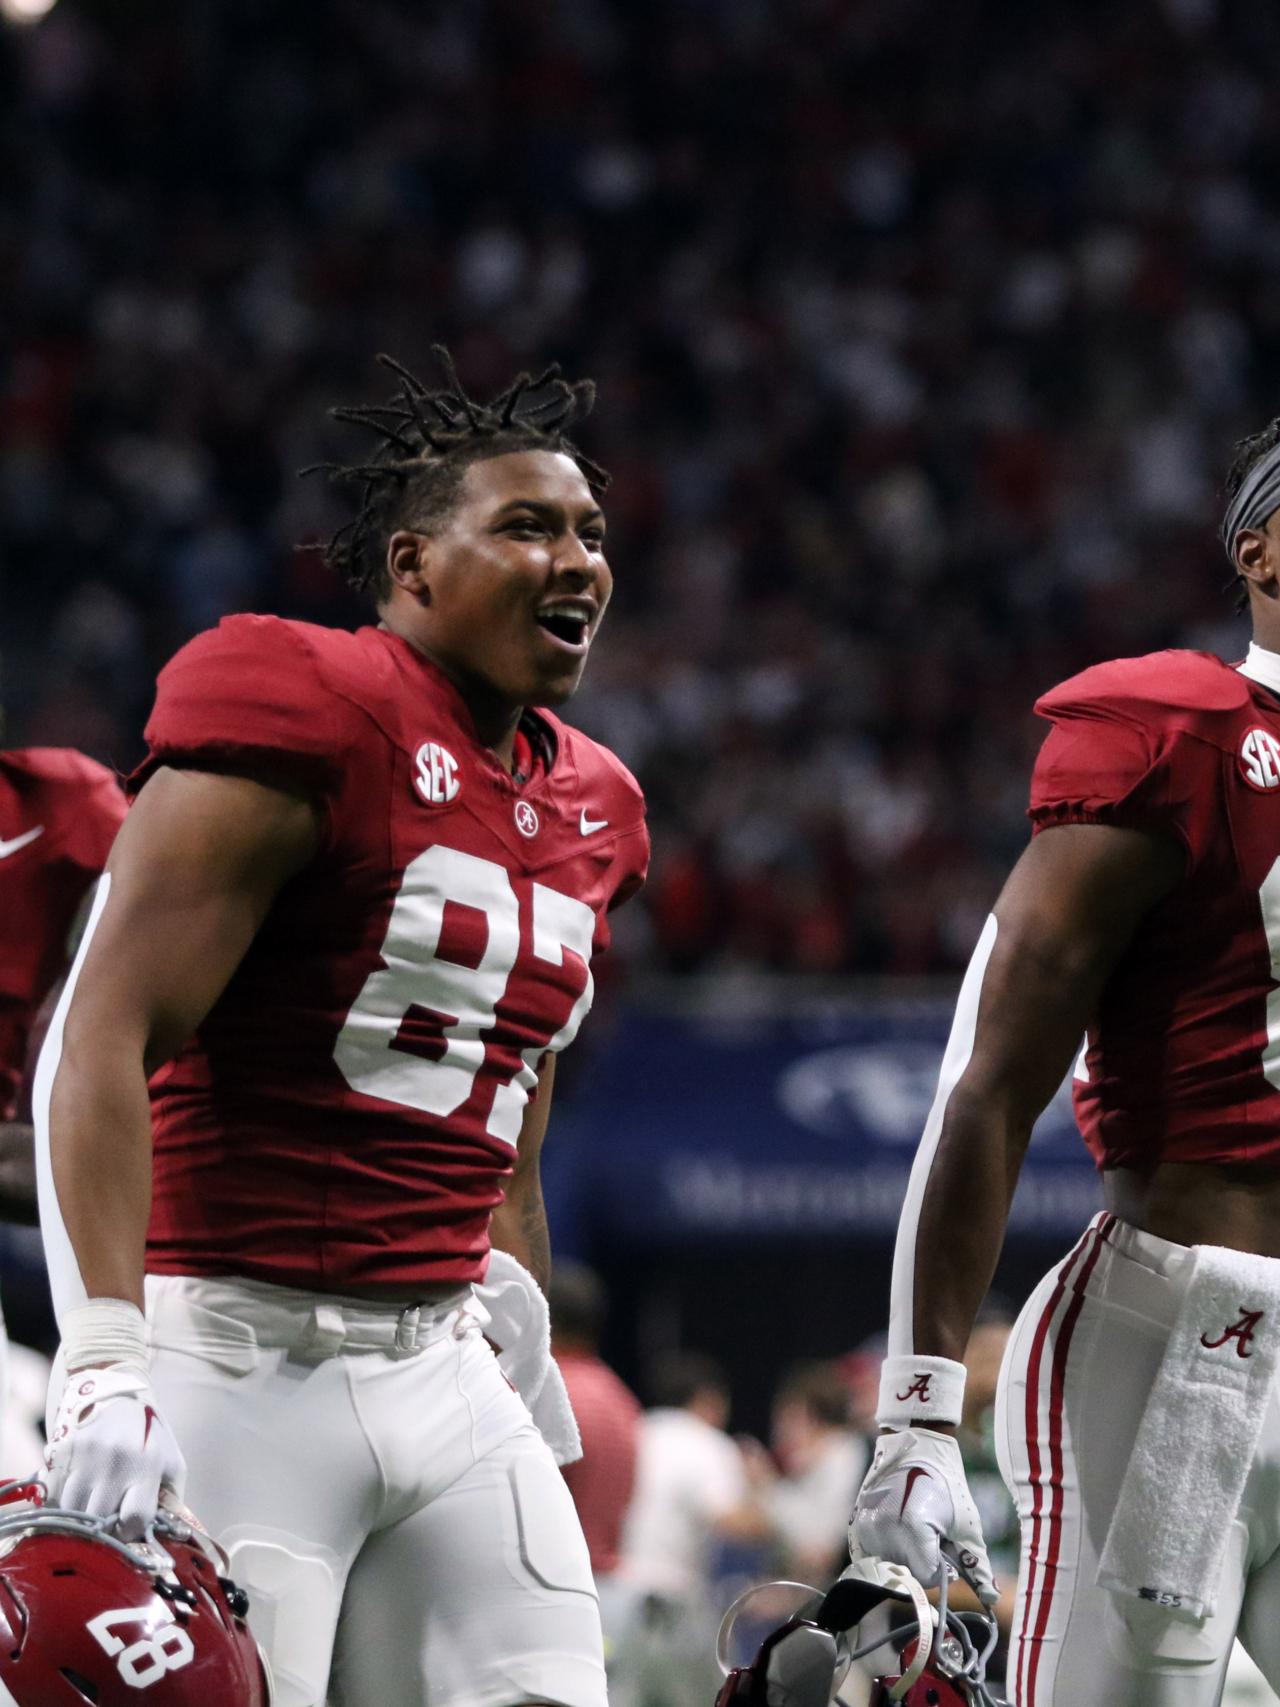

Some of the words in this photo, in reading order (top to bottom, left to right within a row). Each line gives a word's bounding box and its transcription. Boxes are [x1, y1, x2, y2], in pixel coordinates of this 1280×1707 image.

[415, 742, 461, 803] SEC
[332, 844, 597, 1150] 87
[1200, 1306, 1265, 1358] A
[896, 1373, 933, 1403] A
[85, 1593, 195, 1689] 87
